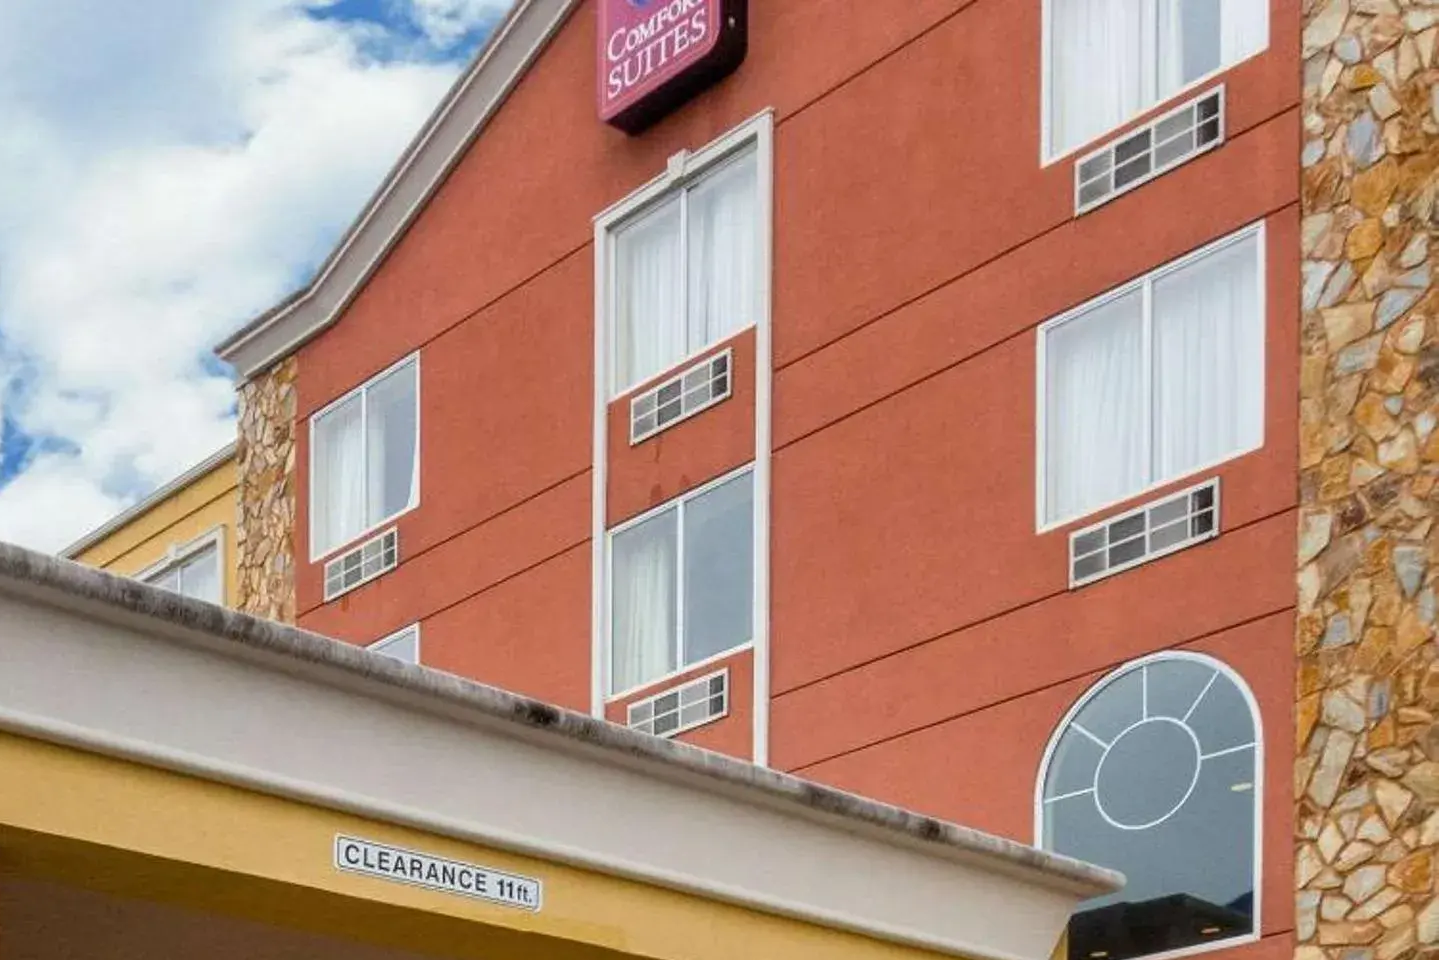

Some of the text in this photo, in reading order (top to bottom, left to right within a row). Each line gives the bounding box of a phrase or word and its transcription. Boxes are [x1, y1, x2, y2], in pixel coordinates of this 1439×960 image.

[607, 0, 703, 61] COMFOR
[608, 8, 706, 98] SUITES
[345, 844, 487, 893] CLEARANCE
